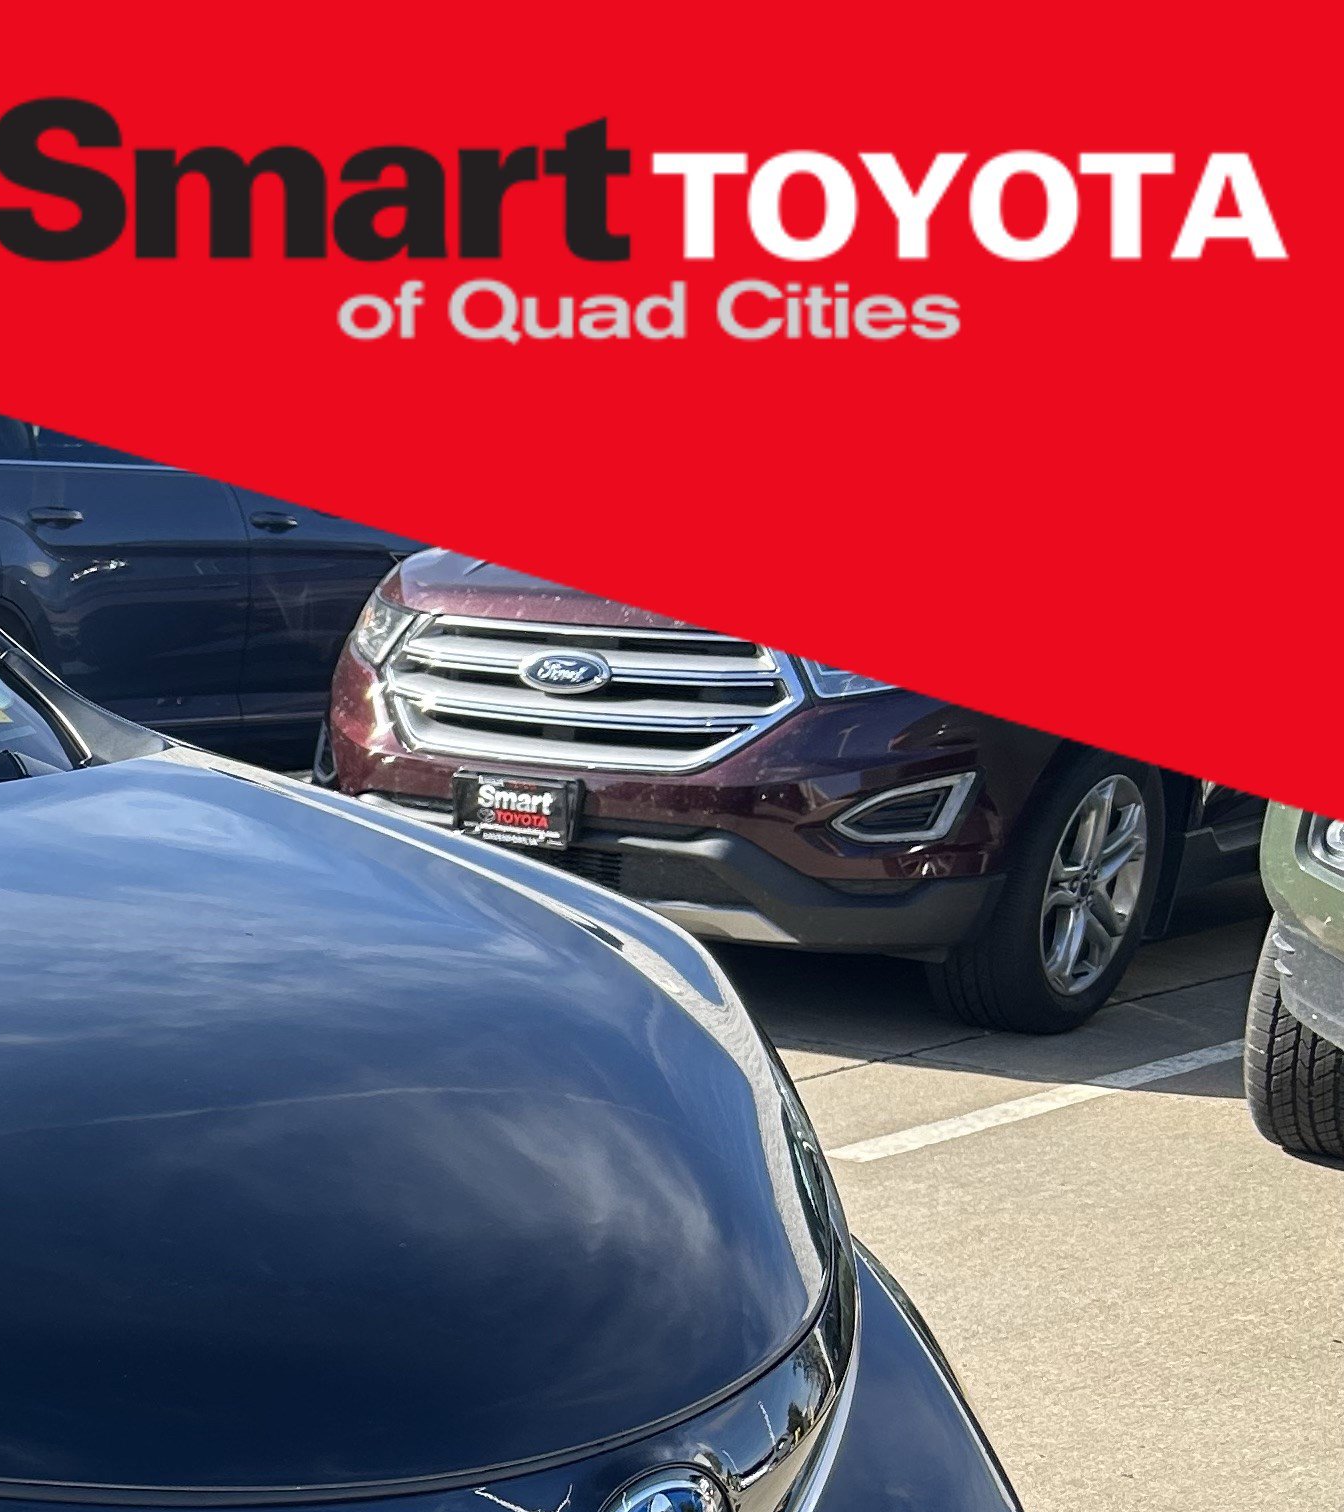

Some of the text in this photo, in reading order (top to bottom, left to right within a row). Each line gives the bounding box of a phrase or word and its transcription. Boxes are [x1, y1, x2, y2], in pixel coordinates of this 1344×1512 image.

[537, 660, 590, 683] Ford
[478, 784, 553, 816] Smart
[495, 809, 549, 828] TOYOTA
